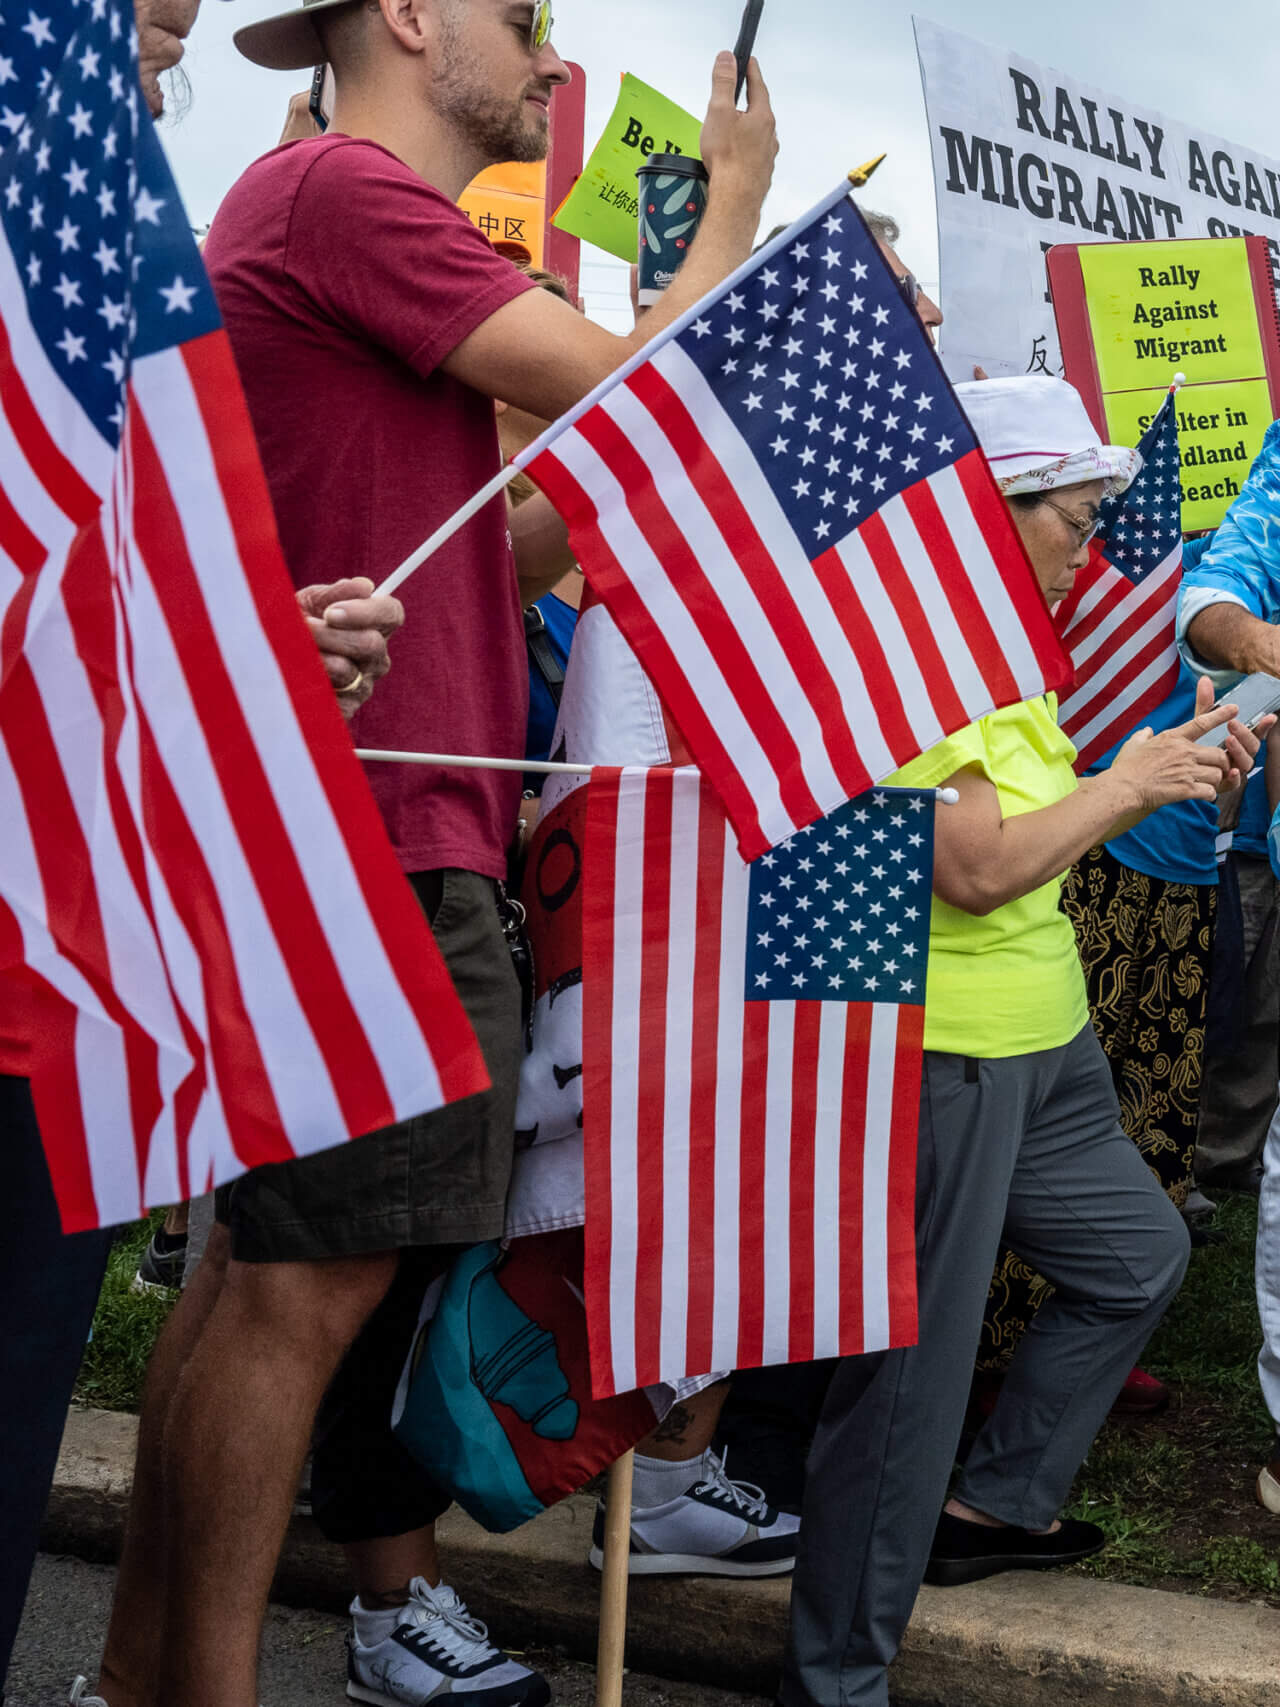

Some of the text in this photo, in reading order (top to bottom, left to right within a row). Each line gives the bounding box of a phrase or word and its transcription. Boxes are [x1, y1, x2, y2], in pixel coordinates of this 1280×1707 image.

[1009, 67, 1166, 180] RALLY
[940, 126, 1183, 241] MIGRANT
[463, 210, 527, 242] 中区
[1138, 265, 1200, 290] Rally
[1133, 299, 1219, 328] Against
[1134, 334, 1228, 362] Migrant
[1225, 407, 1248, 427] in
